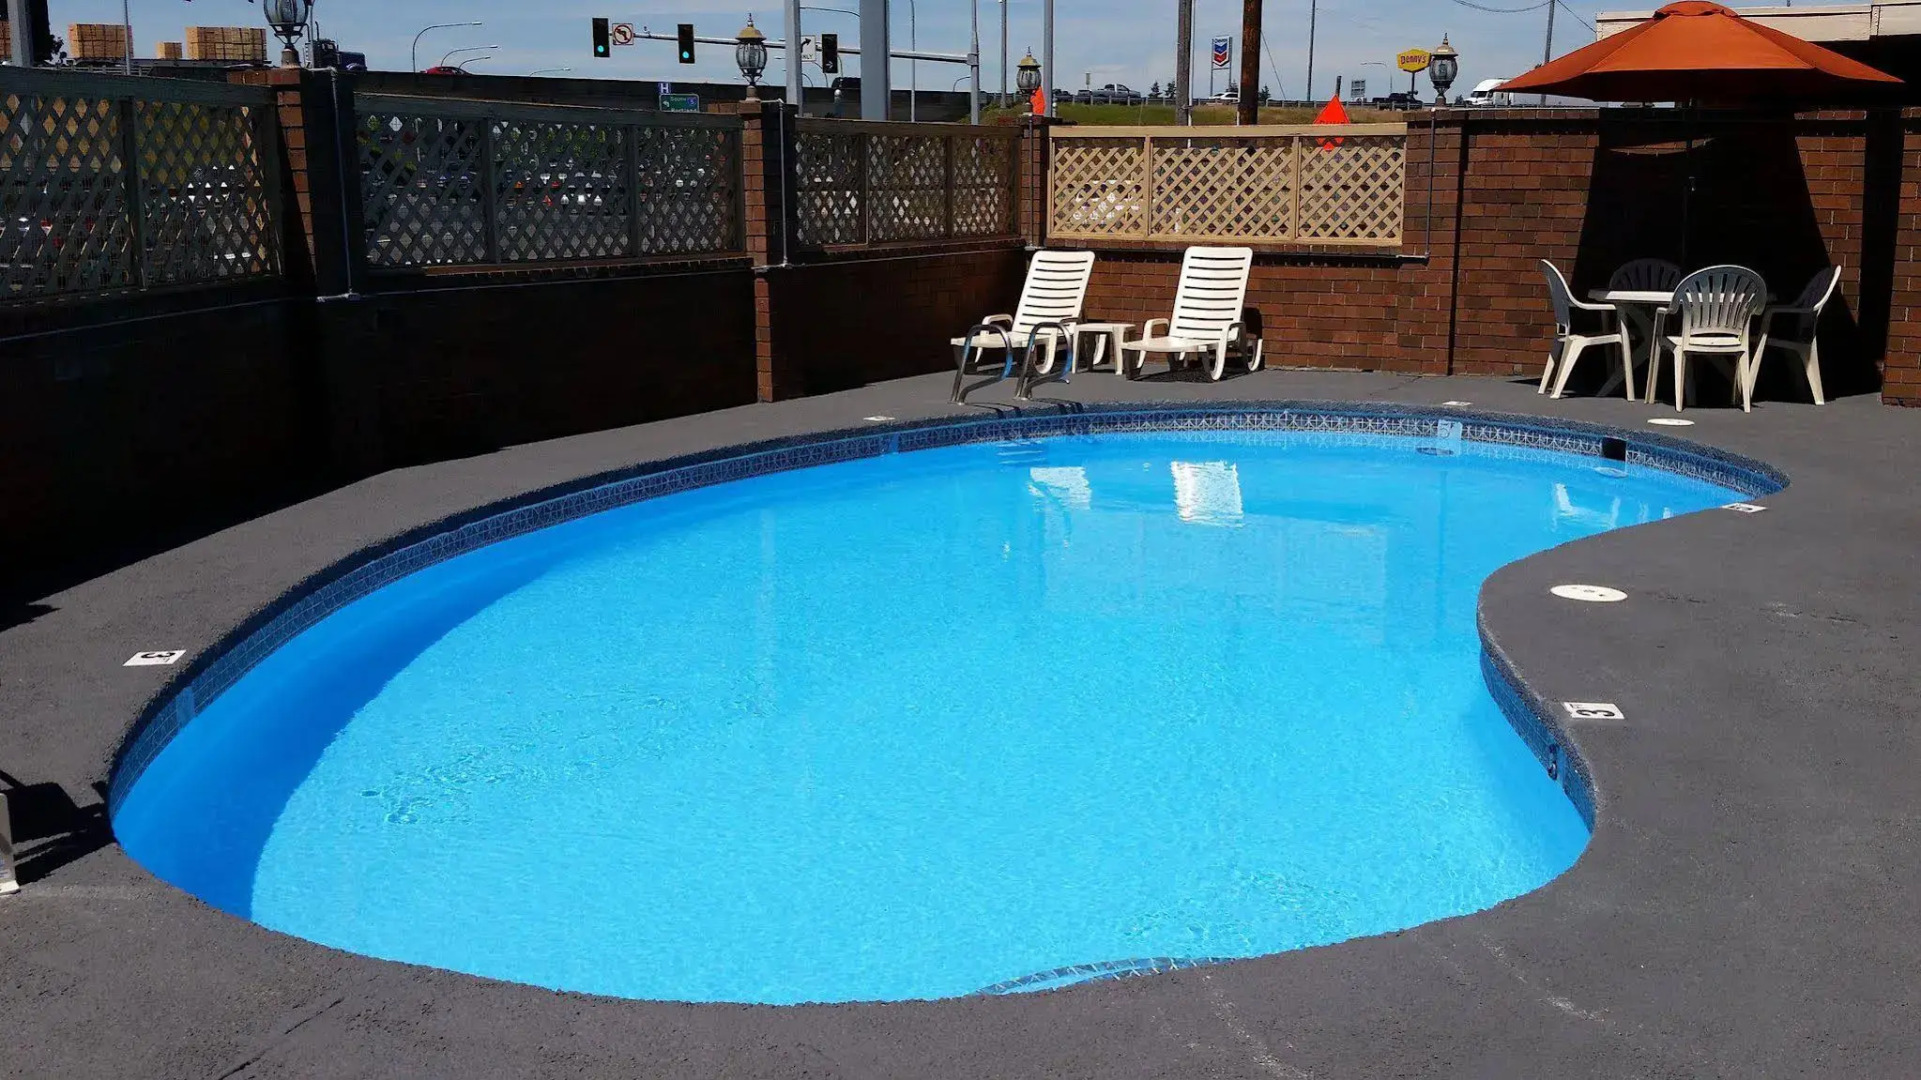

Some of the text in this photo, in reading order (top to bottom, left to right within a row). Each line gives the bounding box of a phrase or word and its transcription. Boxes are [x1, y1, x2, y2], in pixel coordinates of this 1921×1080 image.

[1400, 55, 1427, 65] Denny's
[660, 82, 669, 94] H
[1576, 709, 1615, 717] 3
